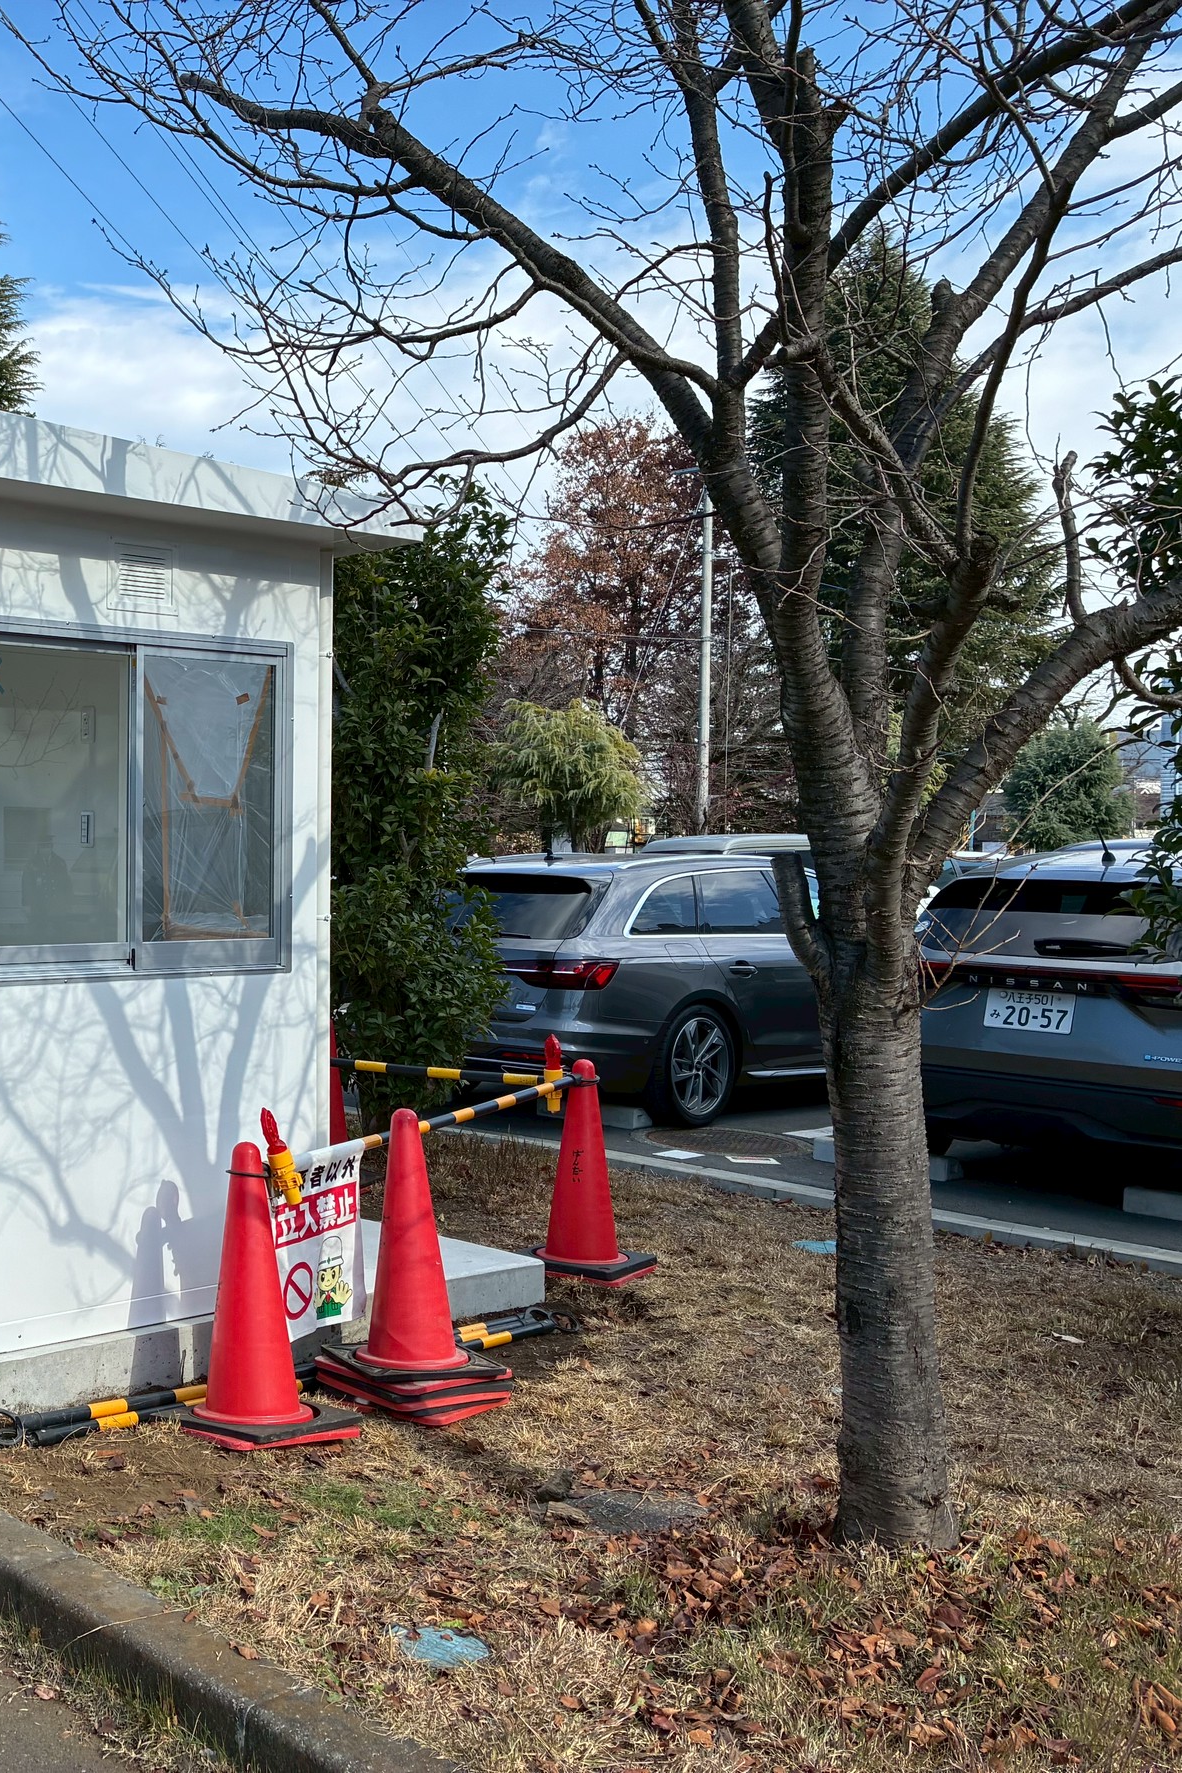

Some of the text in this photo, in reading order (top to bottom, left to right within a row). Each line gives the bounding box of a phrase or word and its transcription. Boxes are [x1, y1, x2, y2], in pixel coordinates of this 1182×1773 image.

[969, 974, 1088, 991] NISSAN
[276, 1188, 355, 1245] 立入禁止
